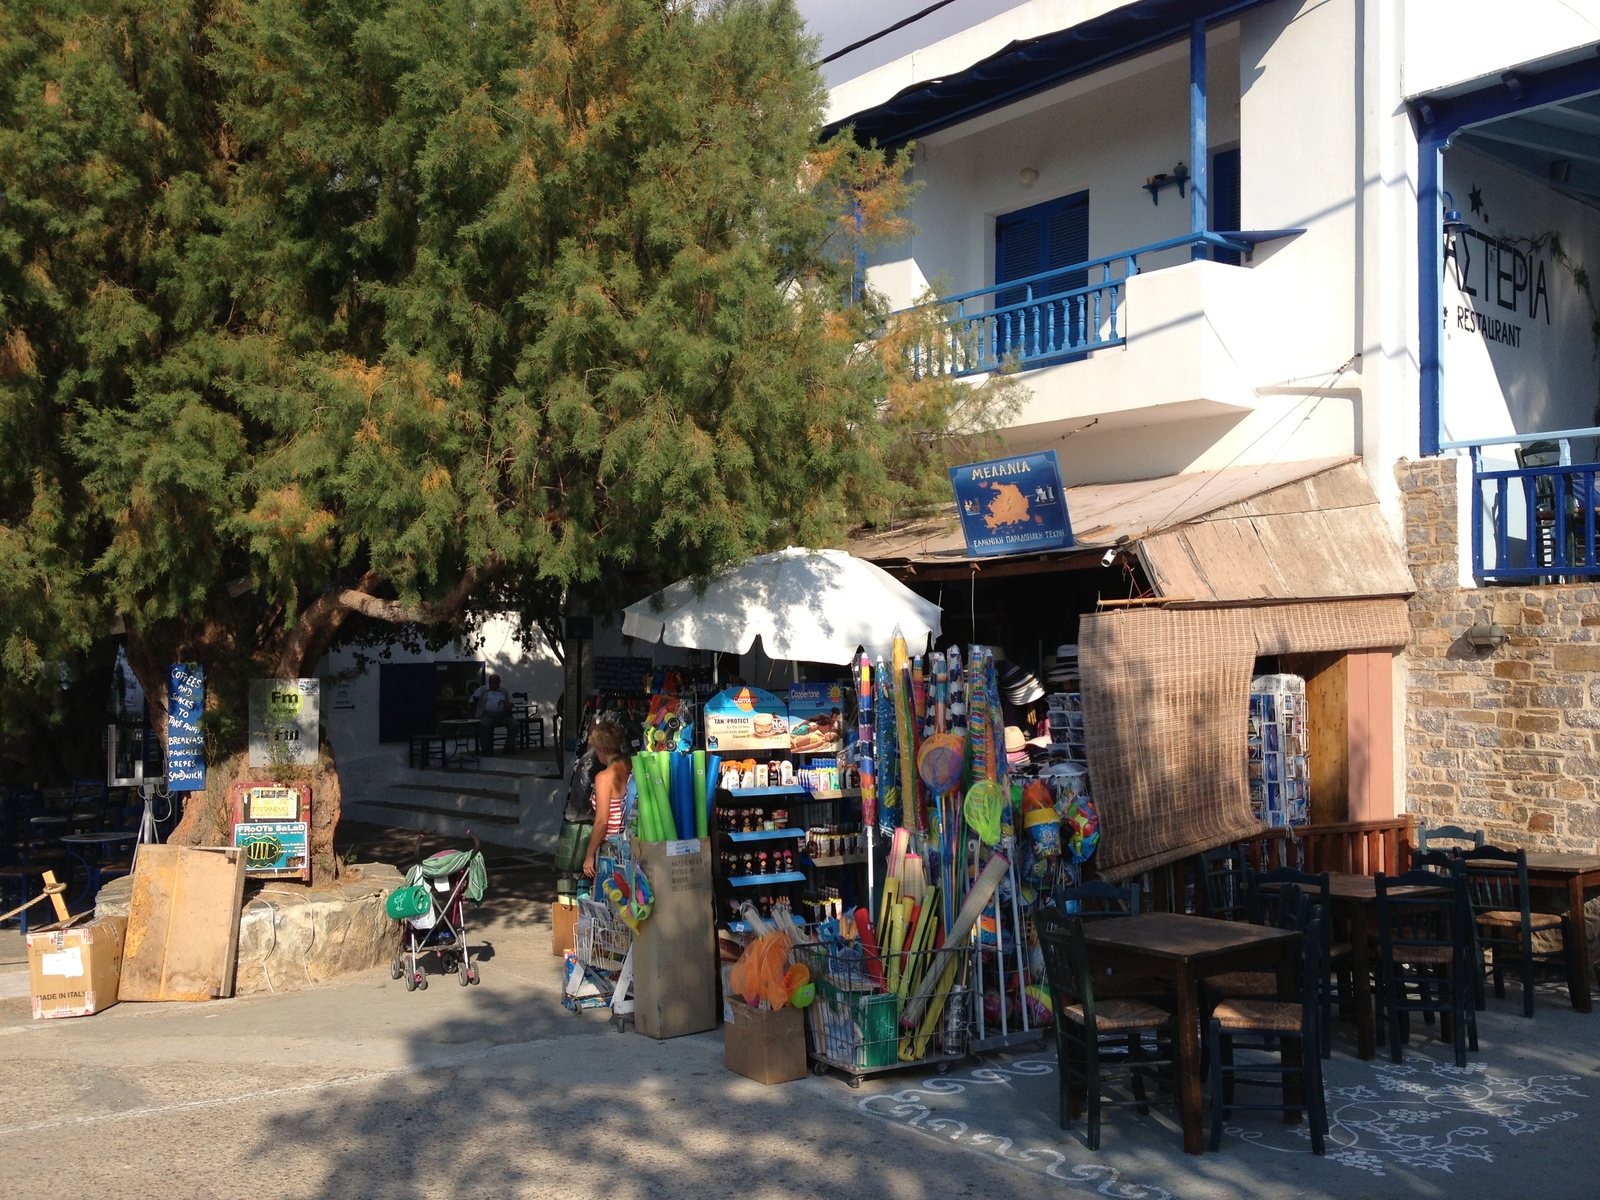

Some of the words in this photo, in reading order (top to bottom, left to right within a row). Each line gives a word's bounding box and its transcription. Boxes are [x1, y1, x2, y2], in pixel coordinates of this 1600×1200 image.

[1457, 305, 1521, 349] RESTAURANT
[971, 460, 1031, 480] ΜΕΛΑΝΙΑ
[171, 667, 202, 689] COFFEES
[178, 684, 193, 697] AND
[170, 692, 194, 710] SNACKS
[179, 707, 189, 718] TO
[168, 714, 183, 728] TAKE
[169, 736, 204, 746] BREAKFAST
[169, 769, 203, 782] SANDWICH
[58, 991, 66, 999] IN
[67, 990, 87, 998] ITALY
